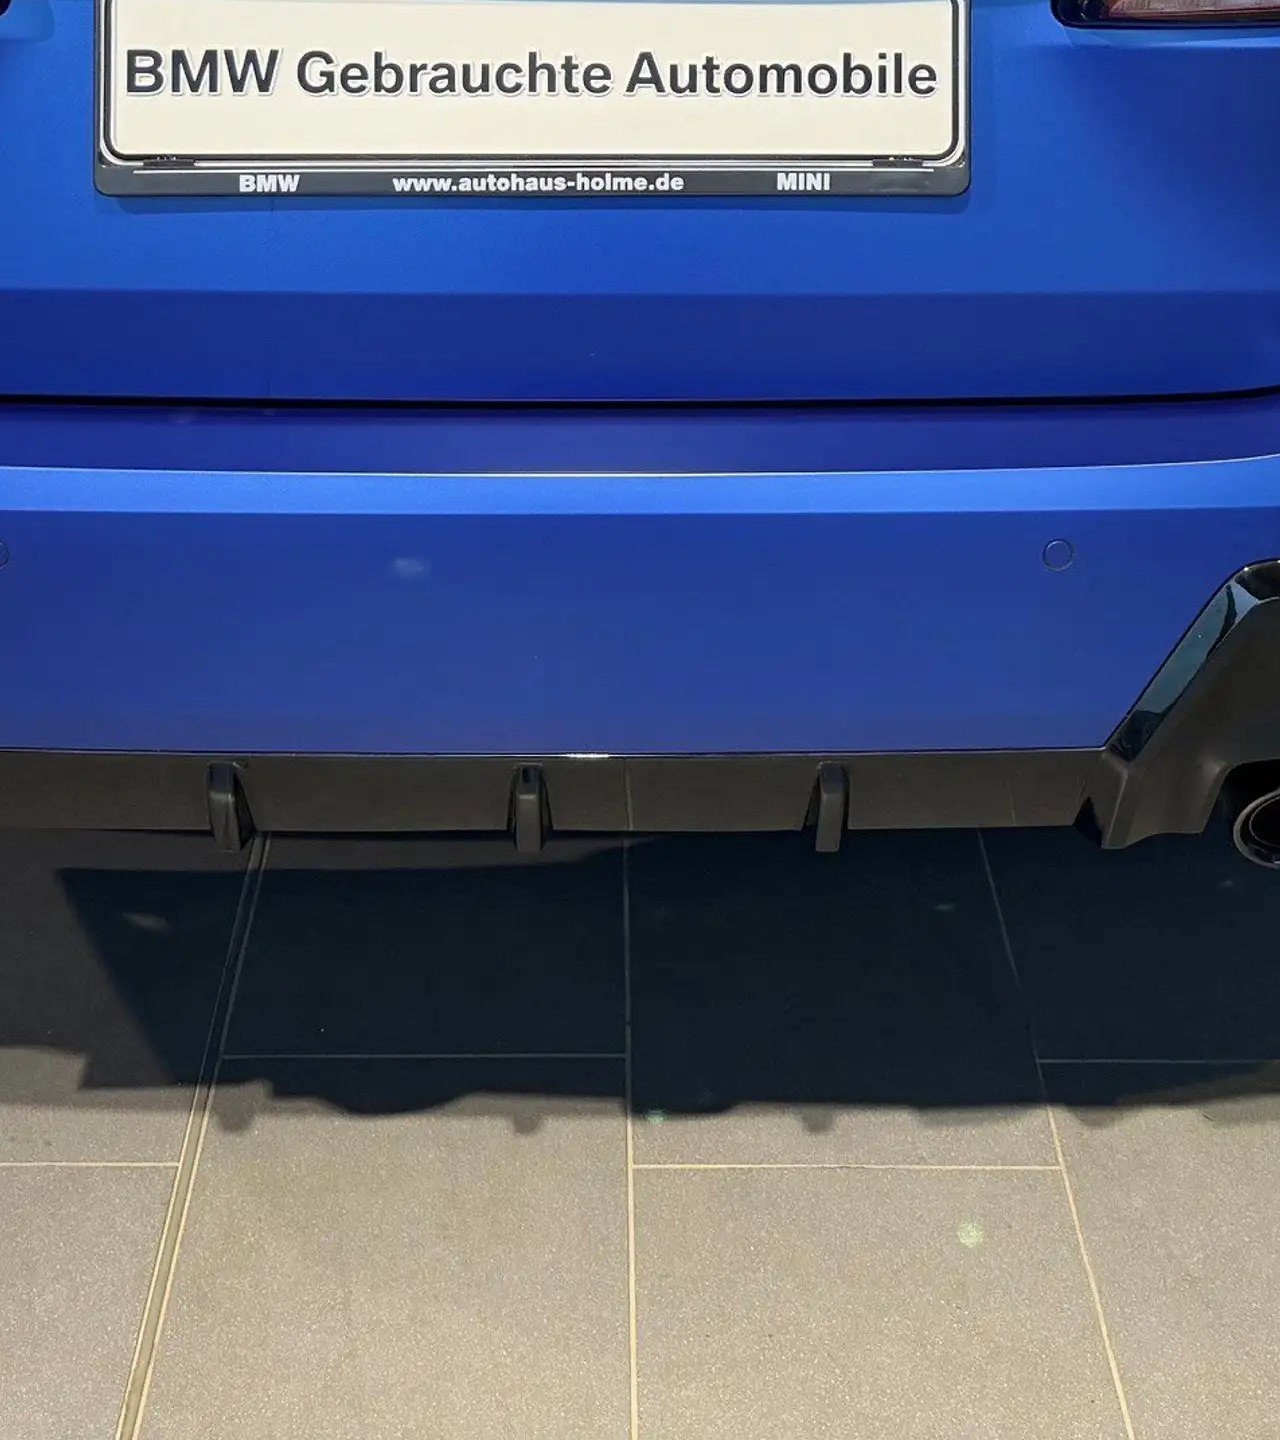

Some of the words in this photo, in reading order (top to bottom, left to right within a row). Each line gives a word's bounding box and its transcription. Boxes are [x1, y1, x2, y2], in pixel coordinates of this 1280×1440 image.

[126, 48, 280, 94] BMW
[296, 50, 612, 95] Gebrauchte
[625, 50, 938, 95] Automobile
[239, 174, 300, 192] BMW
[393, 171, 684, 193] www.autohaus-holme.de
[777, 172, 831, 191] MINI
